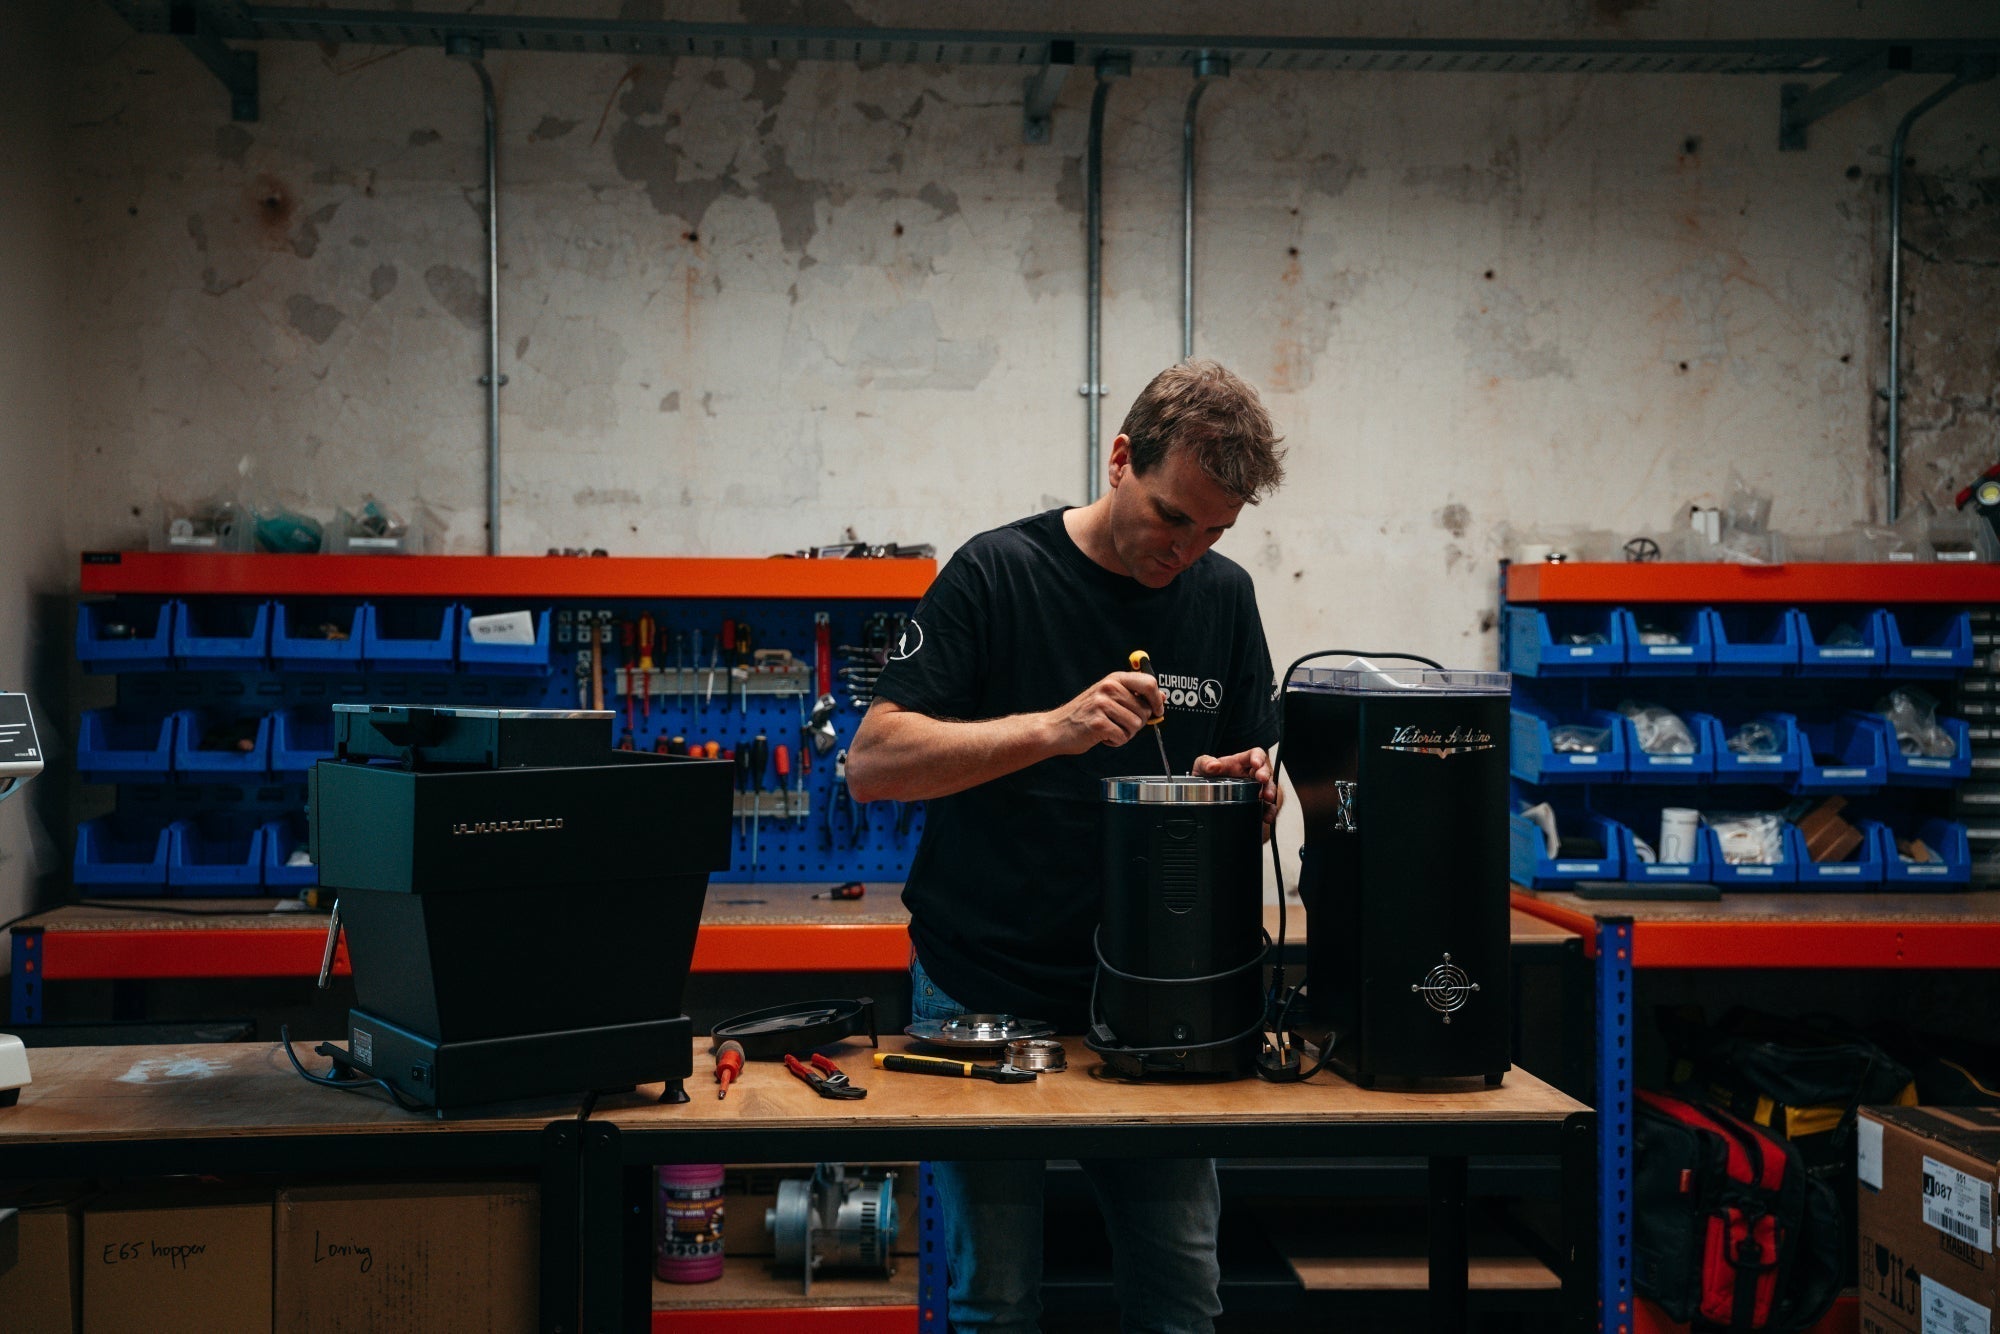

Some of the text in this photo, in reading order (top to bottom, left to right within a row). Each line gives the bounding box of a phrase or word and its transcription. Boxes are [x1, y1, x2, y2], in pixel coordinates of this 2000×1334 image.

[1158, 673, 1199, 691] CURIOUS
[1391, 724, 1491, 744] Victoria Arduino
[474, 818, 563, 834] MARZOCCO
[103, 1240, 206, 1270] E65 hopper
